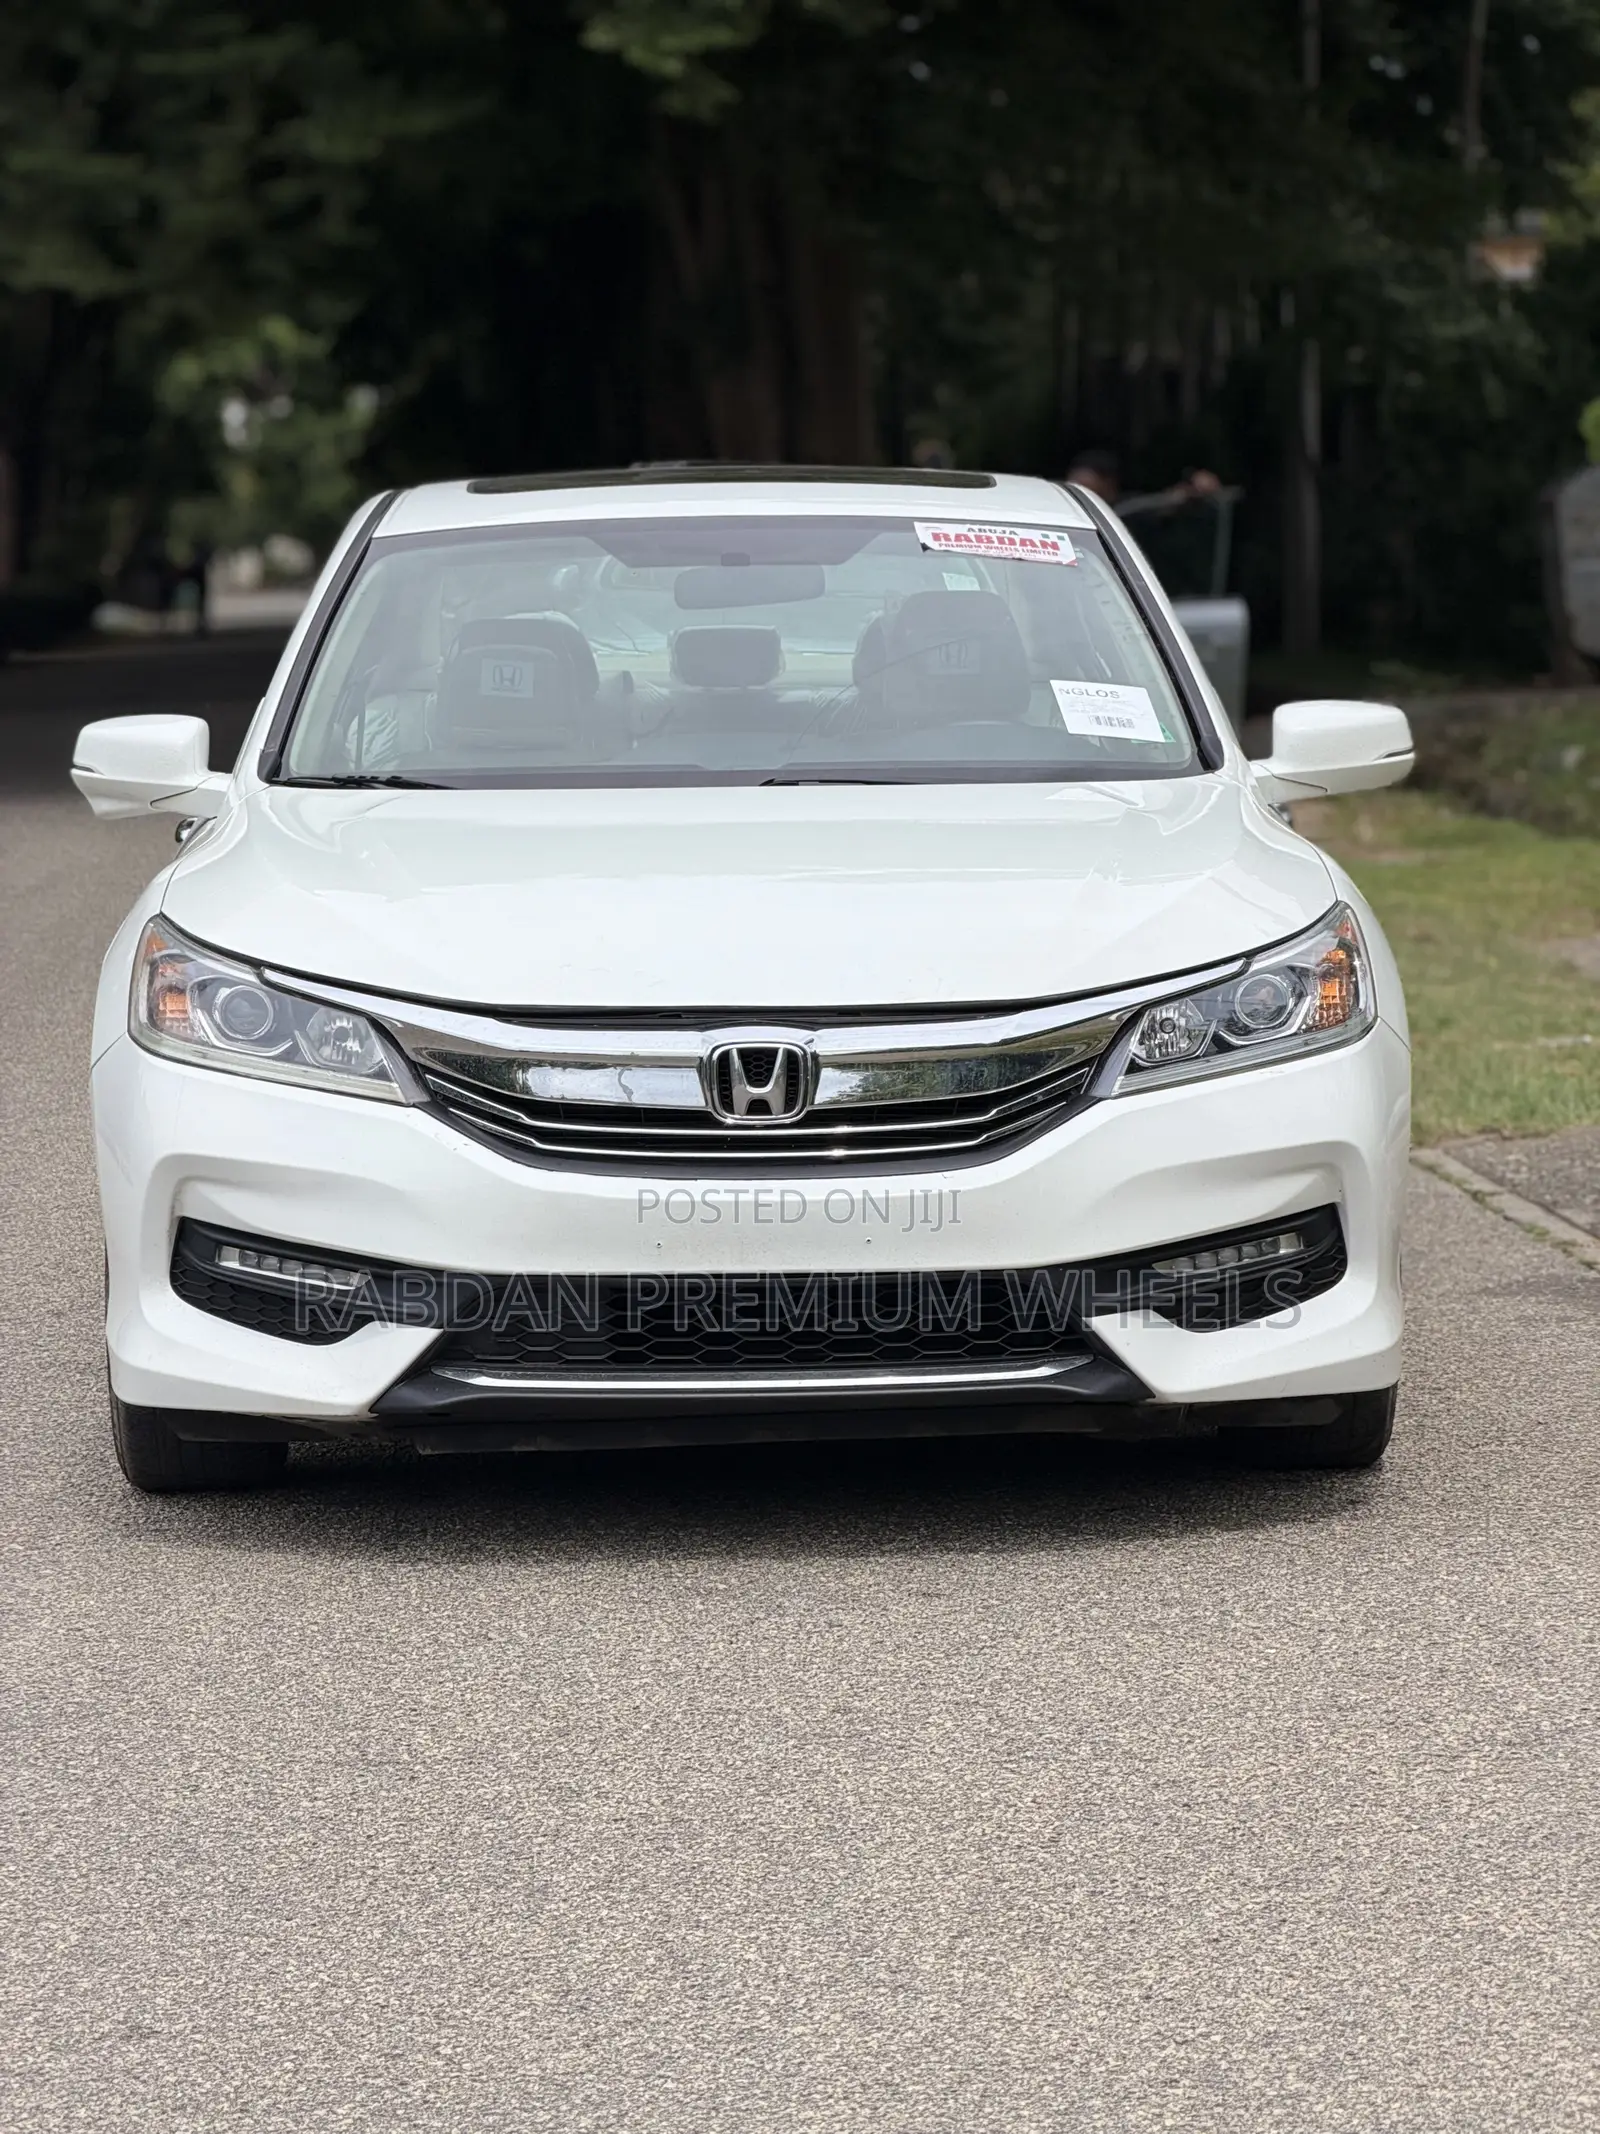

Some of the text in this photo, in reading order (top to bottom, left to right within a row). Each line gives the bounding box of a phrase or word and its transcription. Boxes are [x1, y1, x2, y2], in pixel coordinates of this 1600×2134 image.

[966, 527, 1020, 536] ABUJA
[931, 532, 1061, 551] RABDAN
[984, 545, 1020, 553] WHEELS
[1021, 548, 1059, 557] LIMITED
